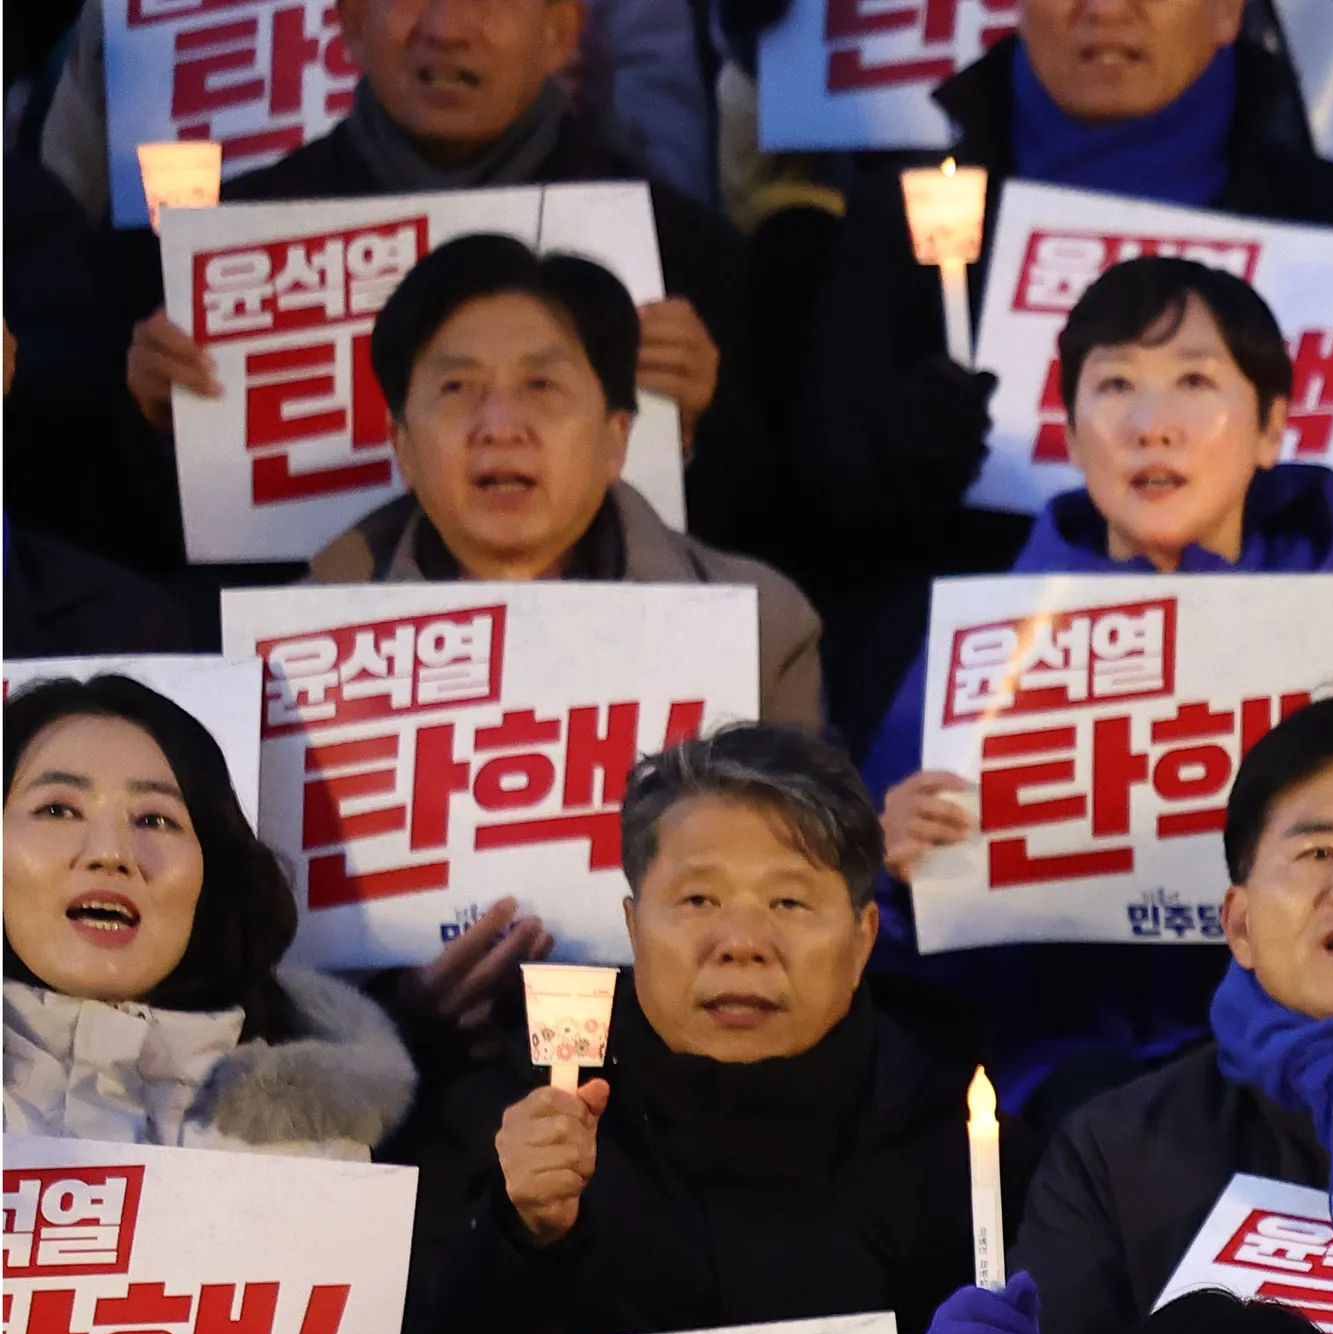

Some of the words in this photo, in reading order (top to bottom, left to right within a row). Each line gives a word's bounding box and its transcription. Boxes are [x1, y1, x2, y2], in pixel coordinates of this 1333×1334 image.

[202, 224, 420, 335] 윤석열
[267, 615, 493, 719] 윤석열
[953, 619, 1167, 714] 윤석열
